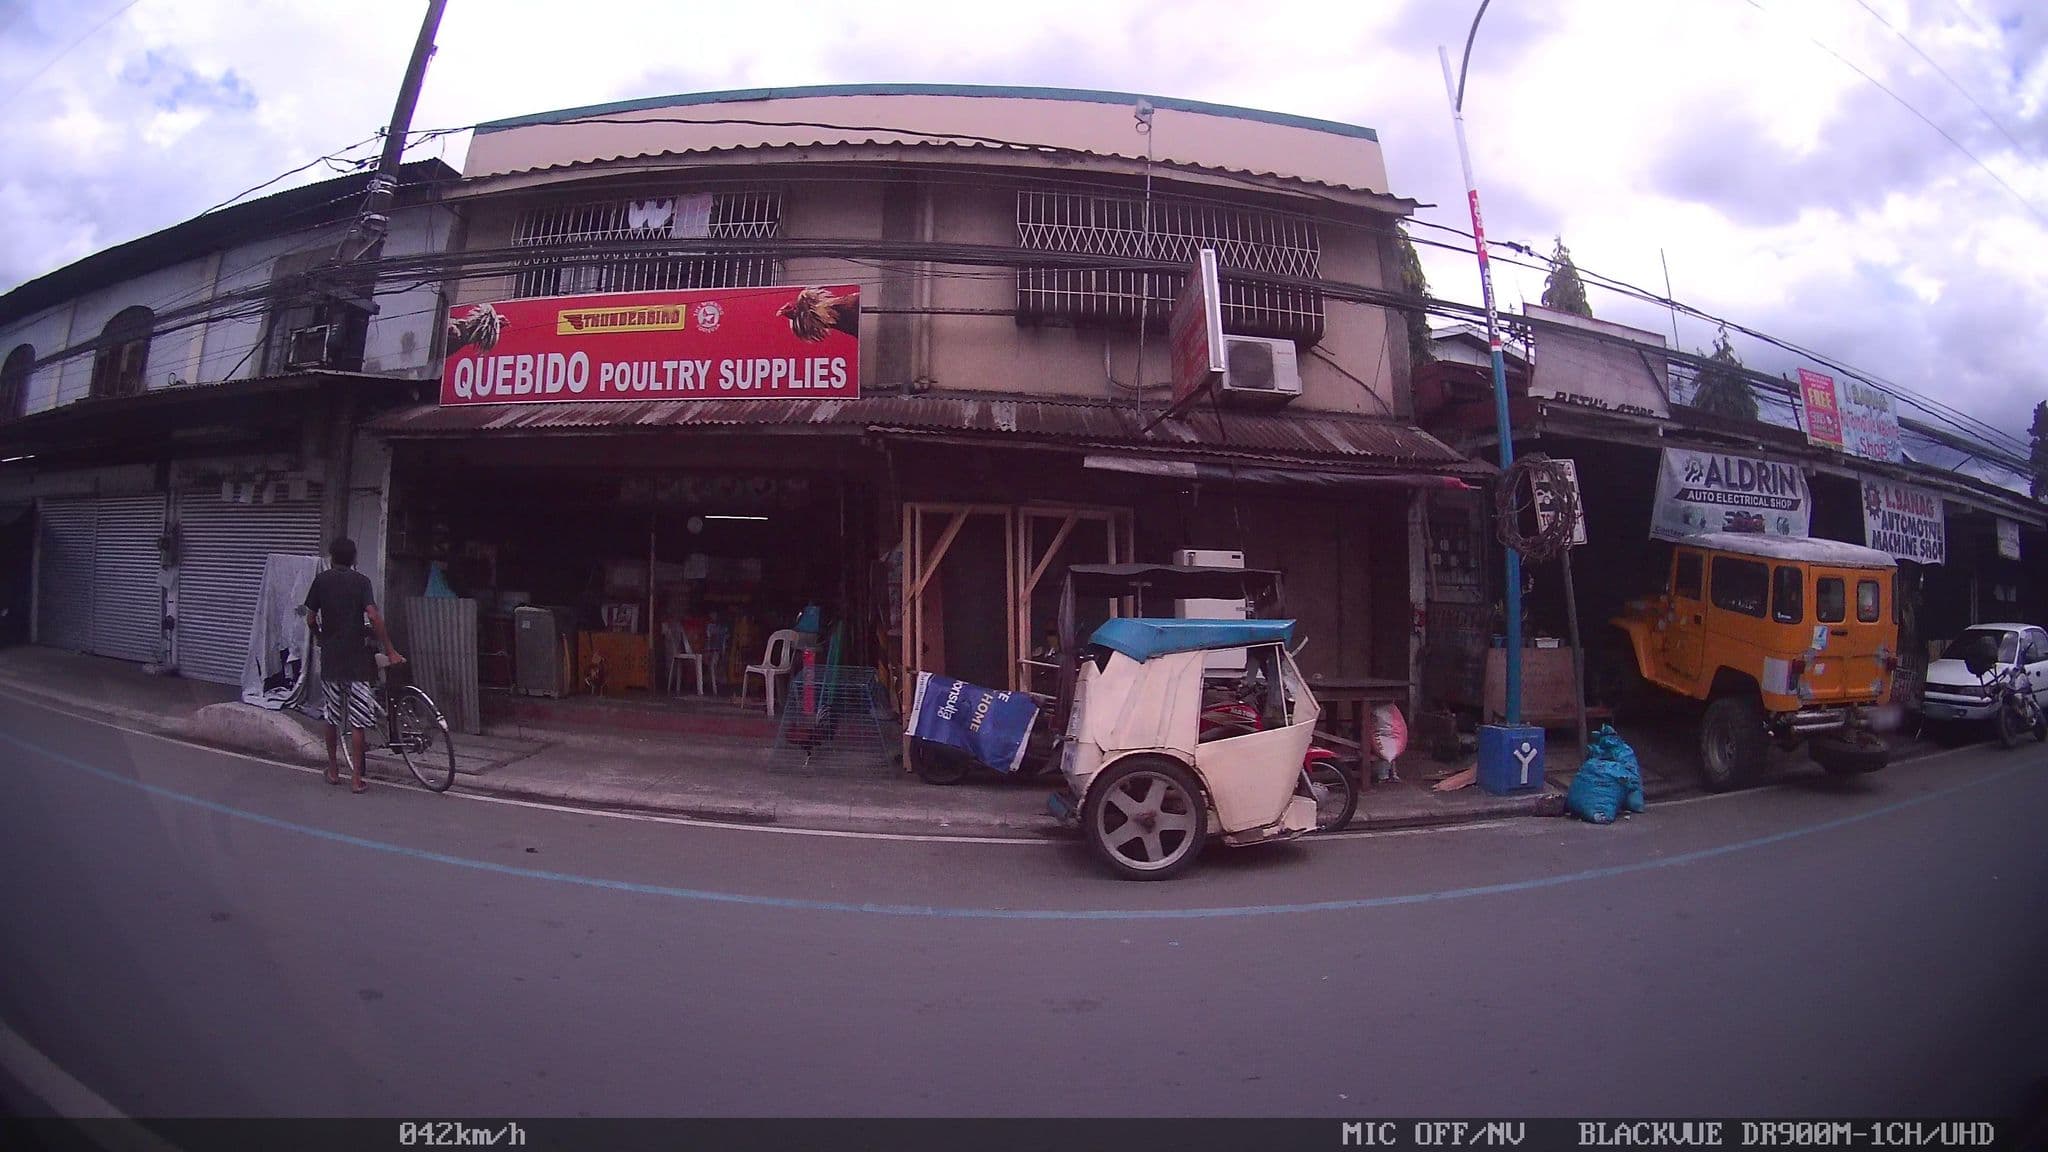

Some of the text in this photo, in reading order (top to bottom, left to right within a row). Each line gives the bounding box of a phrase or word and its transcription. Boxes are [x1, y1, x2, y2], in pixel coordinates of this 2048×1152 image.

[1483, 268, 1500, 336] ANTIPOLO
[454, 351, 848, 399] QUEBIDO POULTRY SUPPLIES
[1807, 388, 1834, 410] FREE
[1860, 436, 1888, 458] Shop
[1703, 455, 1798, 497] ALDRIN
[1687, 490, 1793, 508] AUTO ELECTRICAL SHOP
[1872, 530, 1918, 557] MACHINE
[969, 693, 993, 733] HOME
